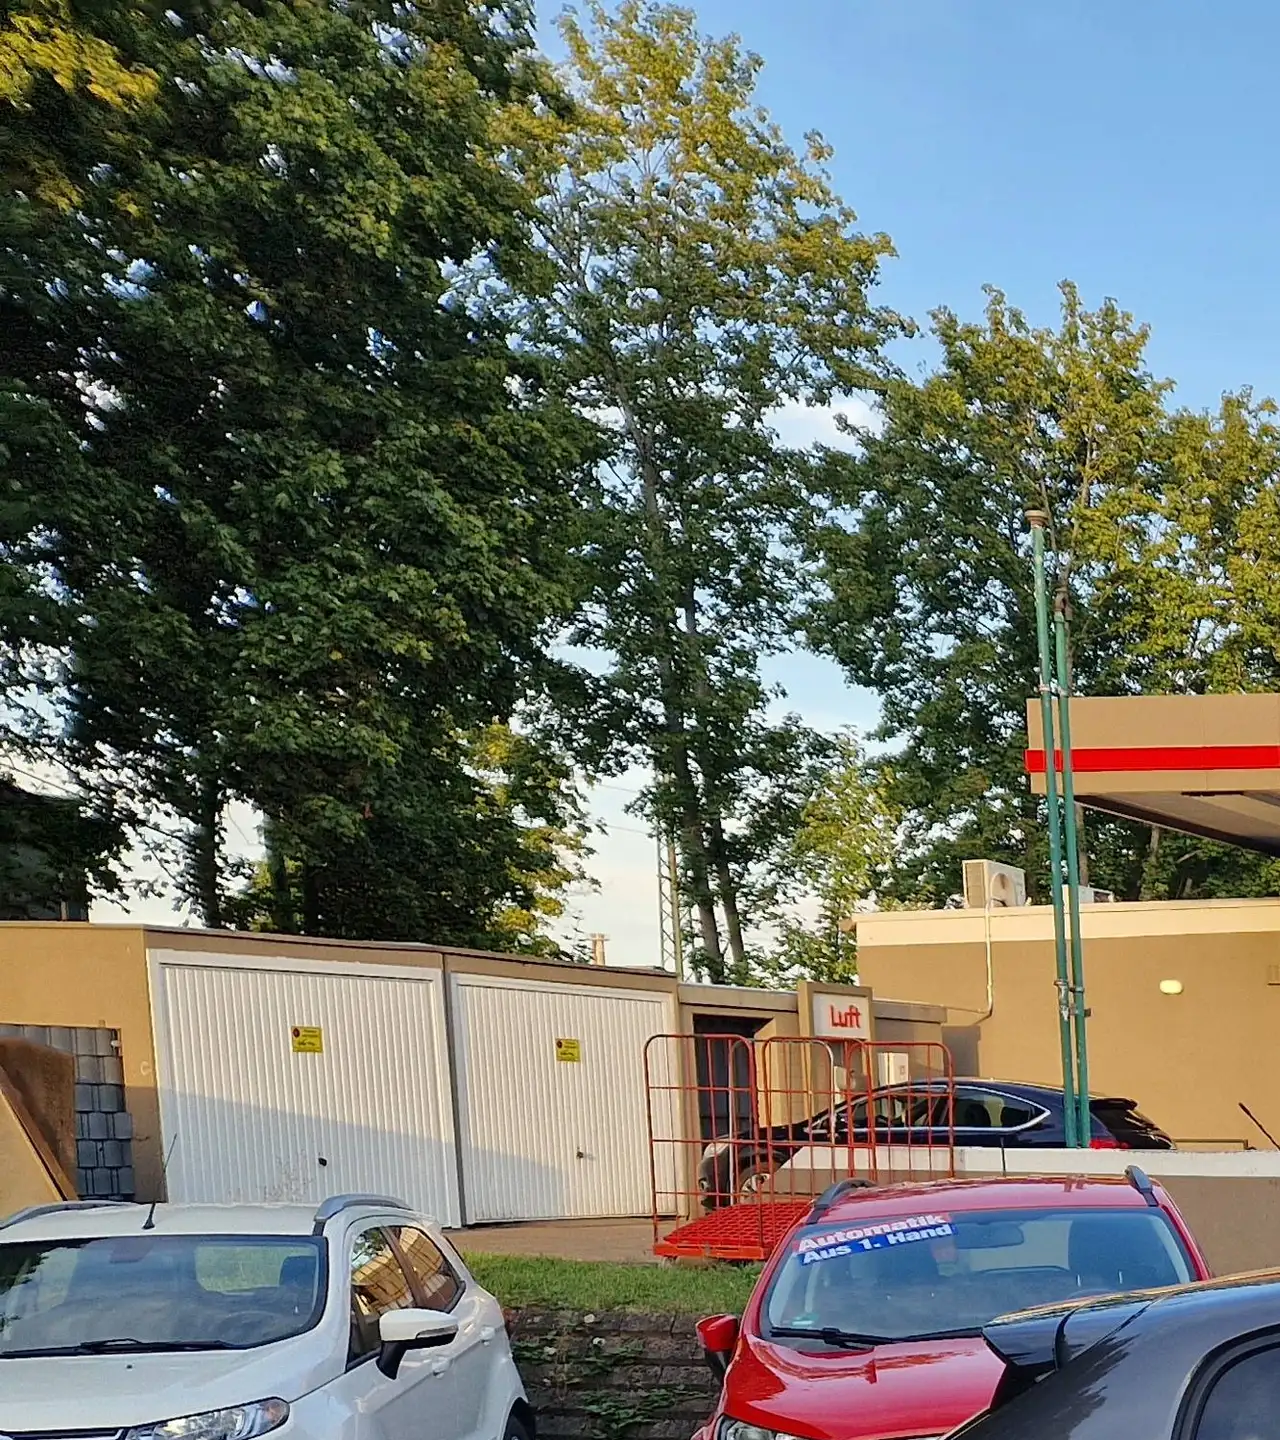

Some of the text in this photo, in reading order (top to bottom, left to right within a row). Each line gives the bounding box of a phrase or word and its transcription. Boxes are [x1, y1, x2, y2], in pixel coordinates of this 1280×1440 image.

[829, 1004, 861, 1028] Luft
[799, 1213, 946, 1252] Automatik
[803, 1224, 953, 1265] Aus 1. Hand
